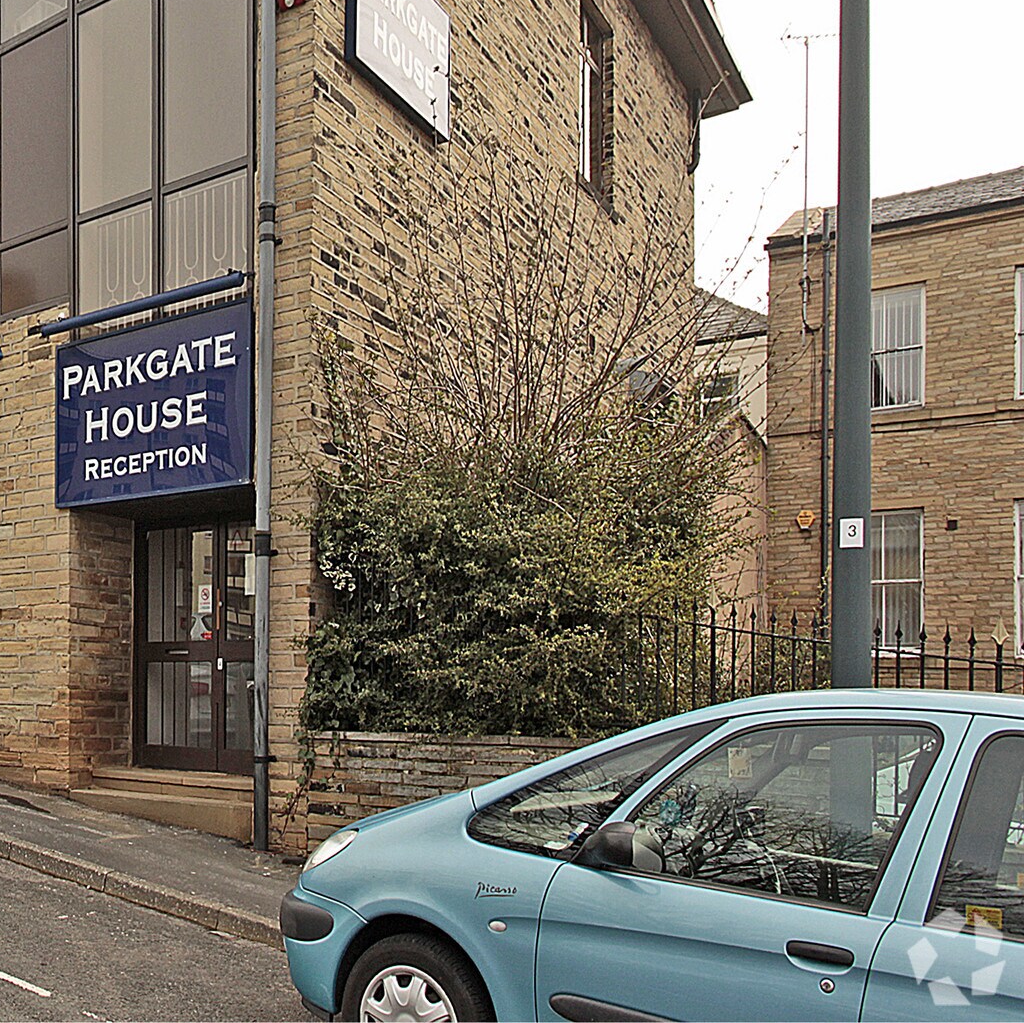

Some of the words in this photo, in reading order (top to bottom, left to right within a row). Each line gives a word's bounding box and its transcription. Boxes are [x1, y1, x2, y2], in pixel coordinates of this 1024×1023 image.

[372, 11, 435, 99] HOUSE
[62, 331, 236, 400] PARKGATE
[85, 390, 207, 444] HOUSE
[84, 443, 207, 481] RECEPTION
[847, 524, 857, 537] 3
[474, 881, 518, 900] Picasso
